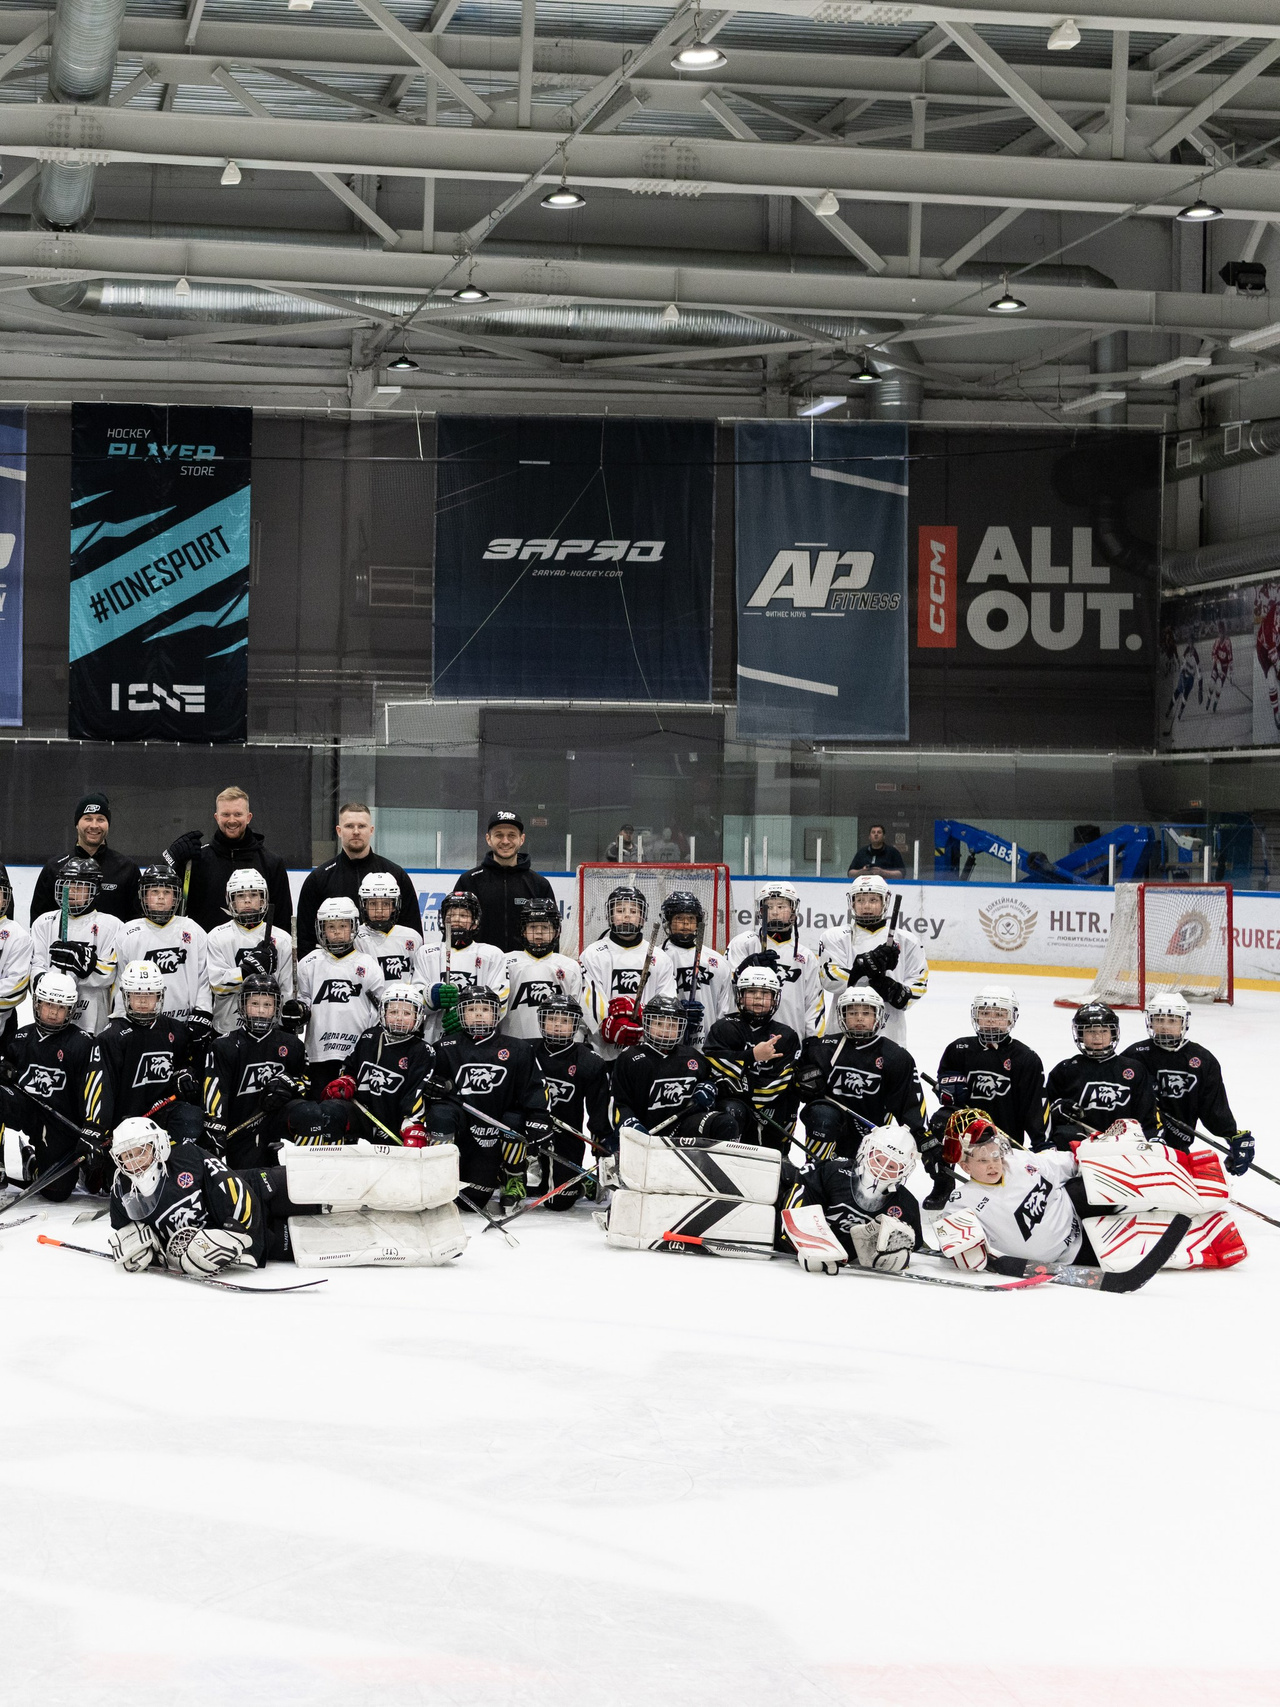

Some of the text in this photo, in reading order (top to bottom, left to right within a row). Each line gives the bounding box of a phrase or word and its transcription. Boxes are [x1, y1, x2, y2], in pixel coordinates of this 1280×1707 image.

[107, 428, 151, 439] HOCKEY
[108, 442, 217, 463] PLAYER
[180, 466, 216, 477] STORE
[482, 538, 667, 563] ЗАРЯД
[966, 526, 1111, 584] ALL
[89, 525, 232, 624] #IONESPORT
[929, 540, 947, 635] CCM
[830, 592, 901, 610] FITNESS
[765, 610, 807, 618] ФИТНЕС КЛУБ
[966, 590, 1143, 651] OUT.
[985, 897, 1032, 914] ХОККЕЙНАЯ ЛИГА
[188, 1014, 213, 1027] AUER
